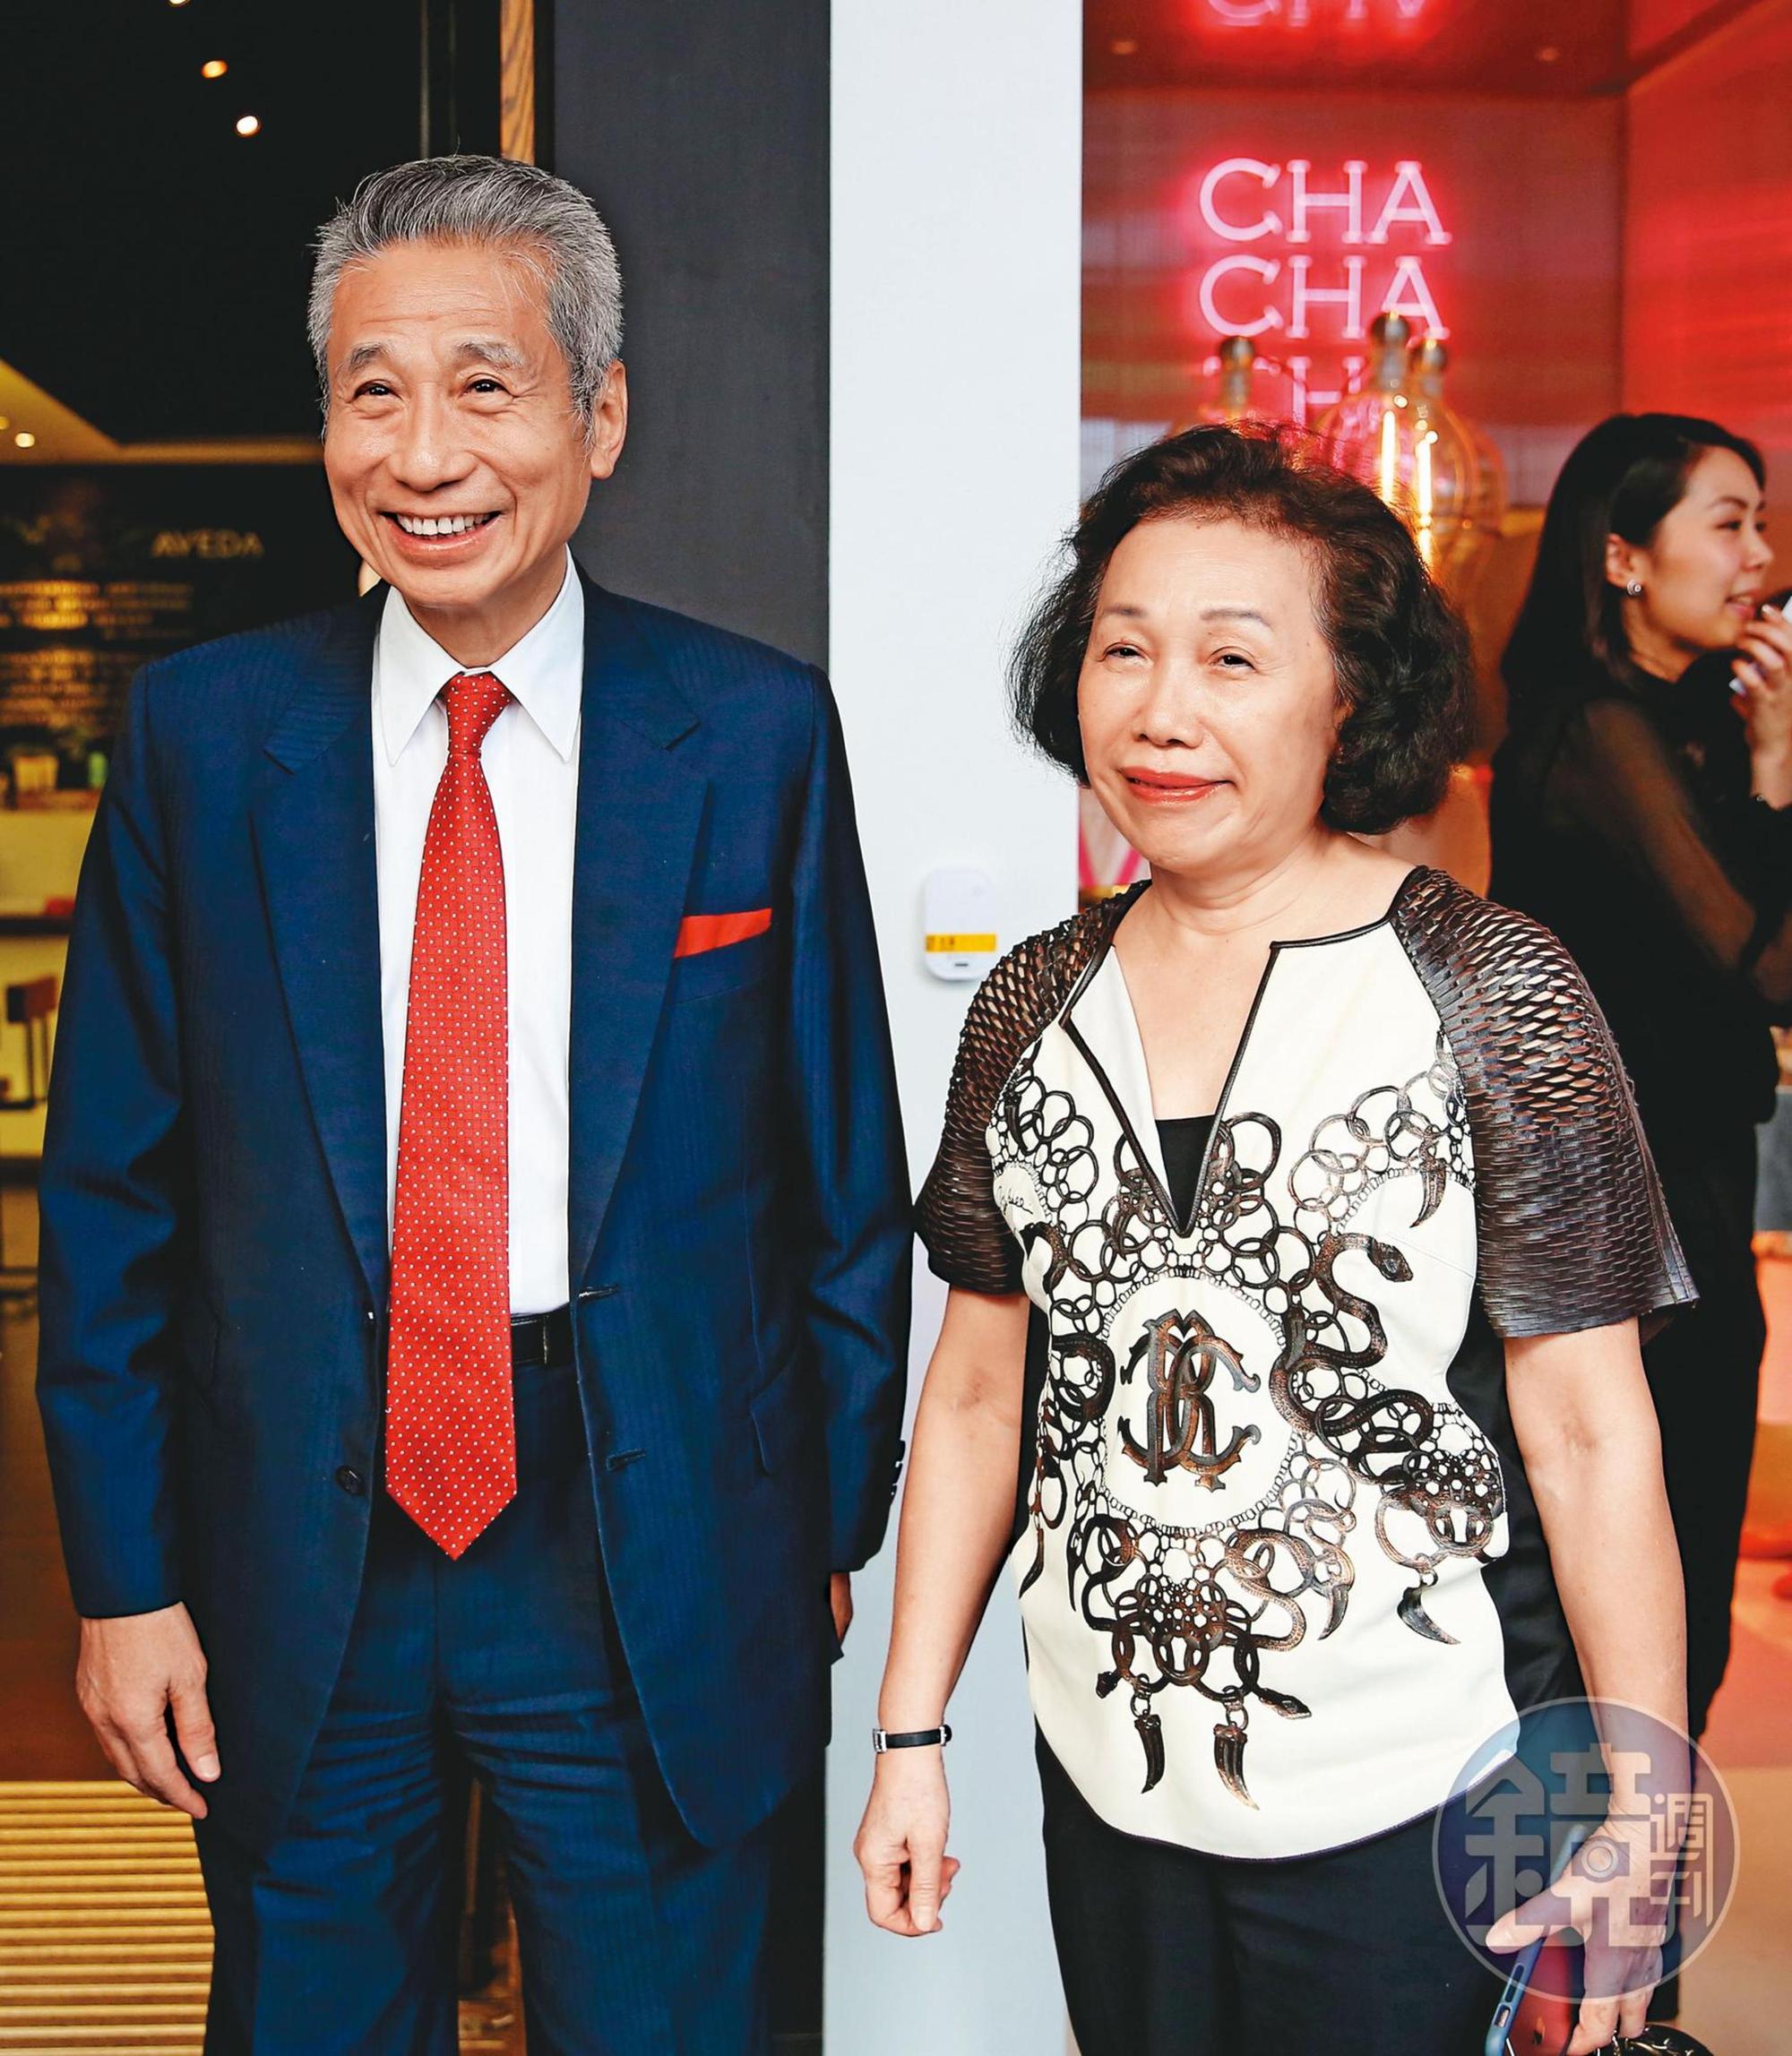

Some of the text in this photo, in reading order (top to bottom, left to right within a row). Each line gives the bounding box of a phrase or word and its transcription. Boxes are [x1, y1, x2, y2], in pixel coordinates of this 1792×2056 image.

[1199, 158, 1452, 245] CHA
[1199, 255, 1450, 340] CHA
[151, 529, 264, 559] AVEDA
